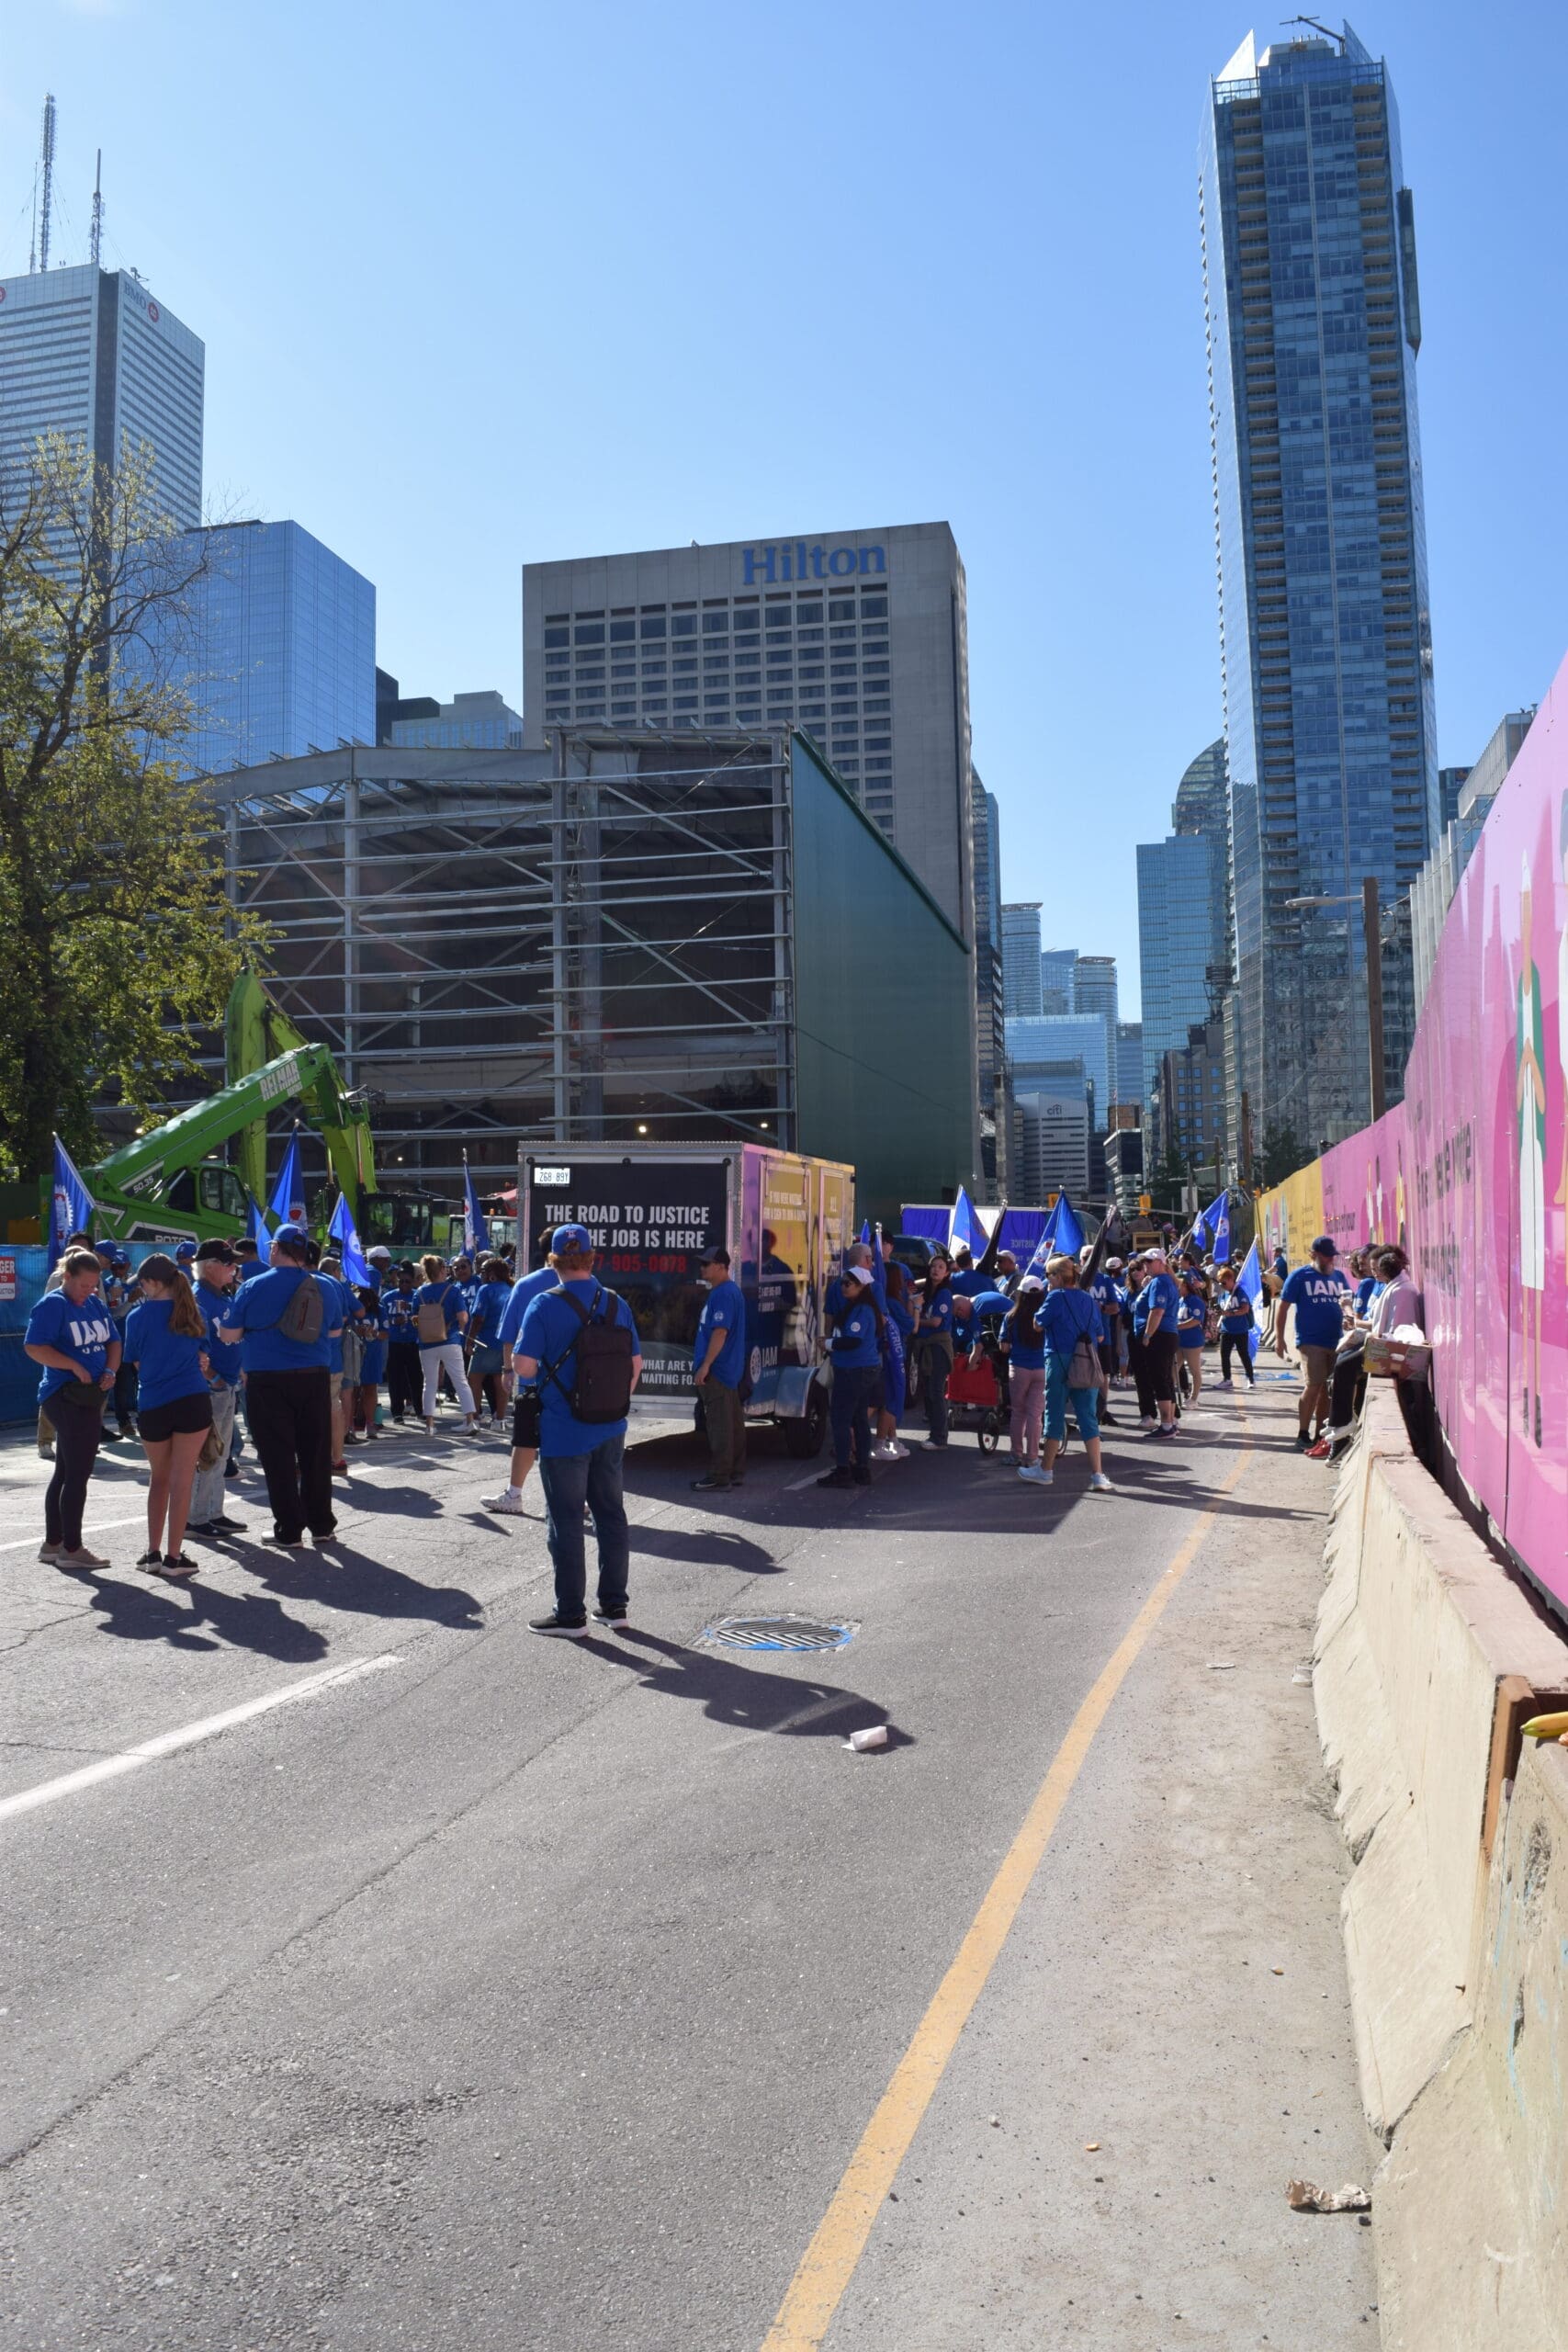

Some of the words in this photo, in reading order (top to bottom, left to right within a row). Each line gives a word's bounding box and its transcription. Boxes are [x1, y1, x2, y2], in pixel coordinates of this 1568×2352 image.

[124, 281, 147, 310] BMO
[742, 542, 886, 586] Hilton
[545, 1204, 573, 1222] THE
[577, 1205, 620, 1223] ROAD
[625, 1206, 643, 1224] TO
[648, 1206, 709, 1225] JUSTICE
[590, 1229, 606, 1247] HE
[611, 1229, 639, 1248] JOB
[645, 1230, 660, 1248] IS
[664, 1231, 705, 1249] HERE
[0, 1261, 16, 1273] GER
[641, 1359, 665, 1371] WHAT
[667, 1360, 685, 1372] ARE
[761, 1345, 778, 1368] IAM
[641, 1373, 679, 1385] WAITING
[682, 1374, 695, 1385] FO
